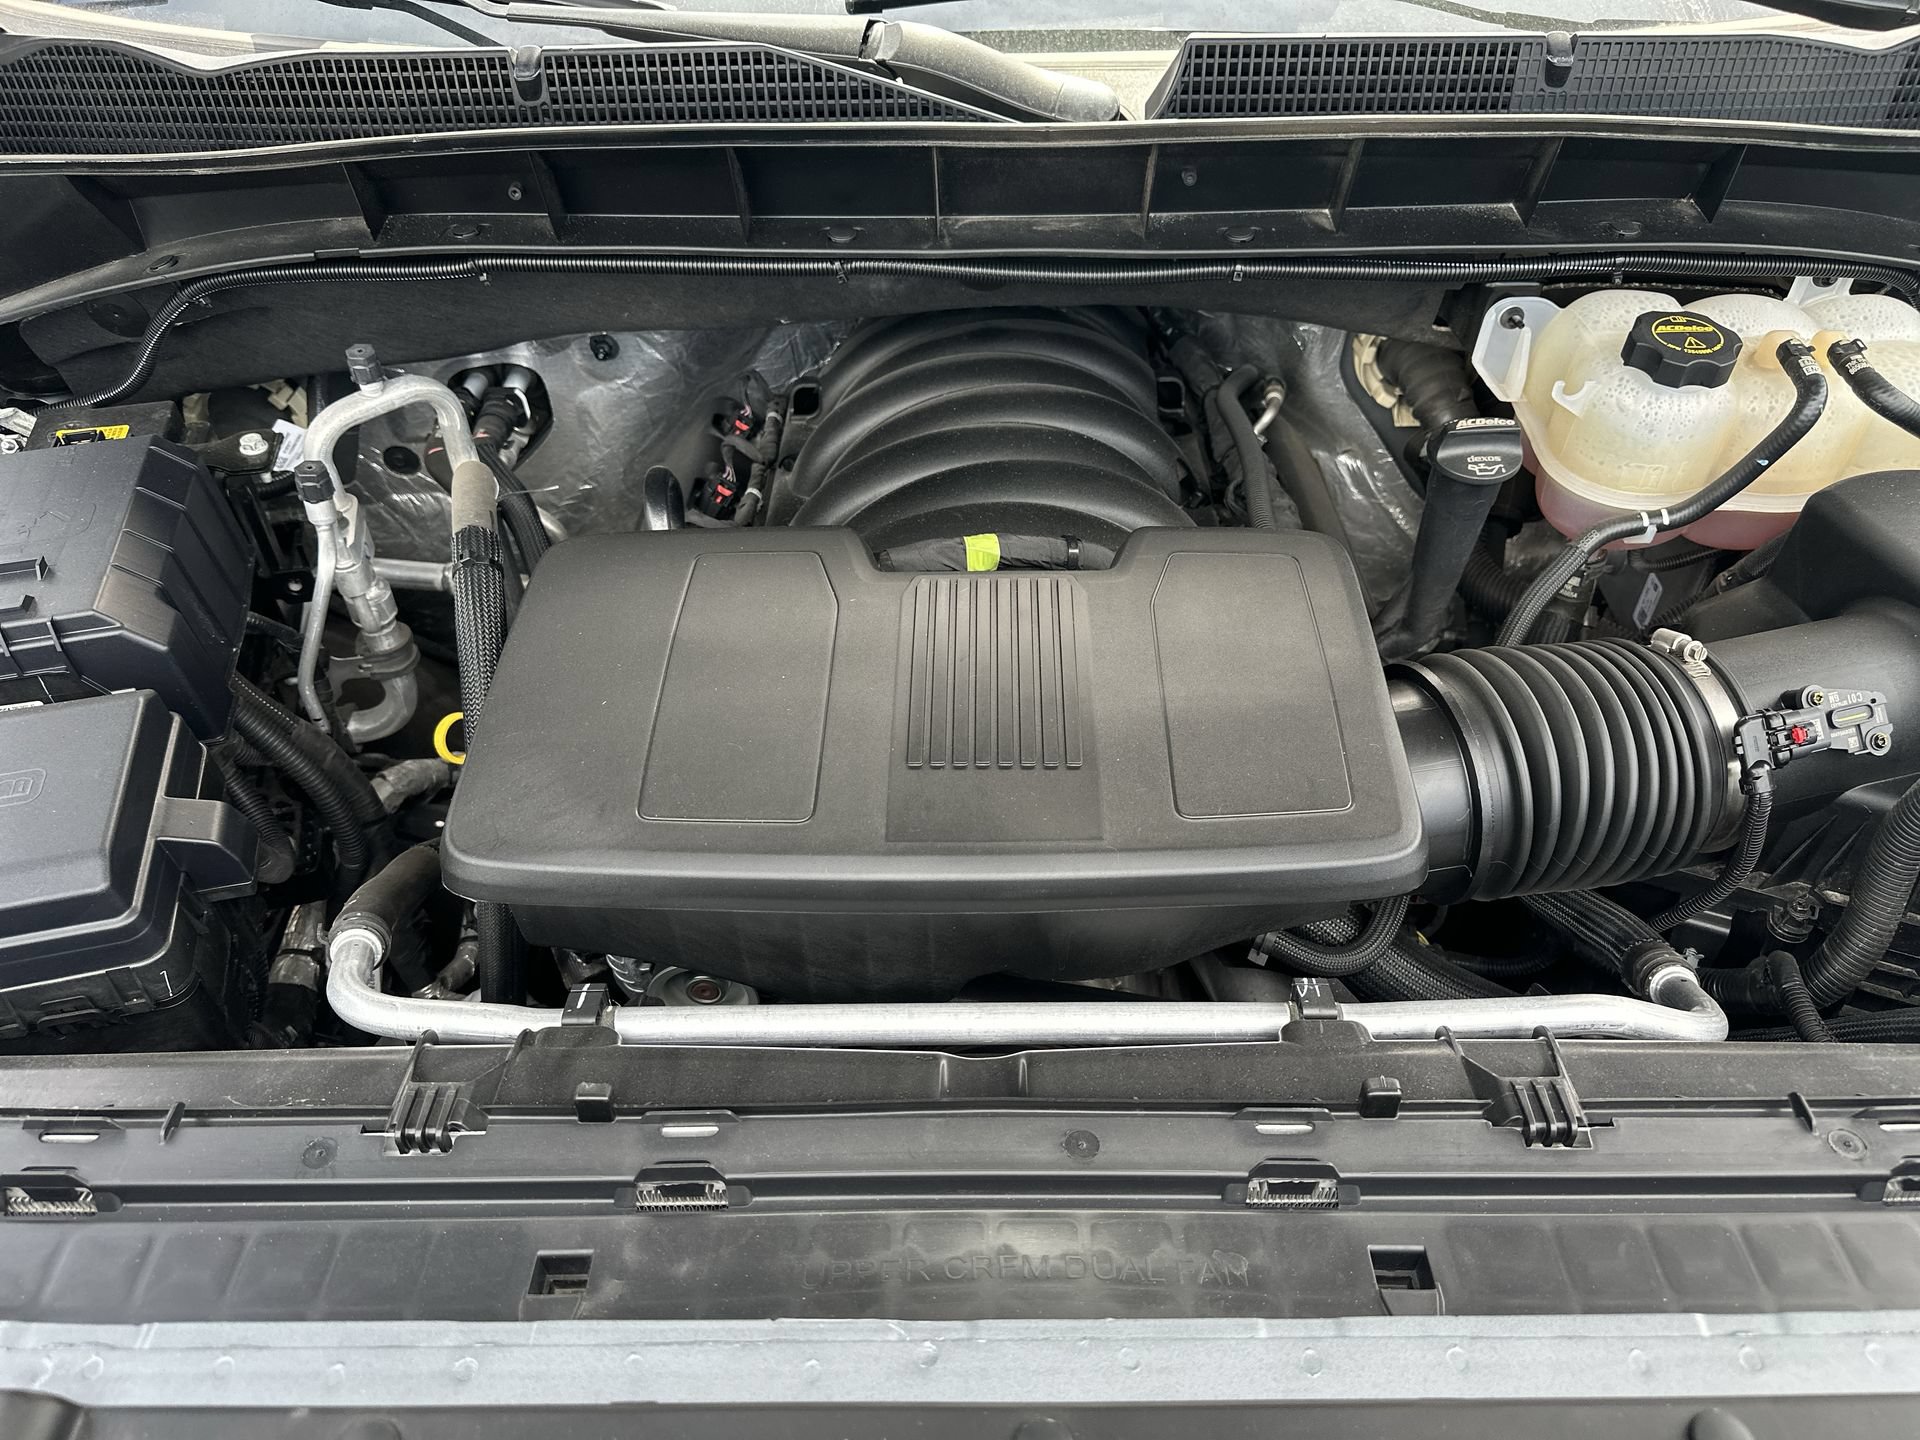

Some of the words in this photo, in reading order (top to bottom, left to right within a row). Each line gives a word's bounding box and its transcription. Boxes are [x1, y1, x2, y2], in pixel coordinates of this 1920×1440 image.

[1655, 325, 1714, 333] ACDelco
[1456, 418, 1516, 430] ACDelco
[1466, 455, 1502, 463] dexos
[1065, 1255, 1166, 1283] DUAL
[1178, 1249, 1249, 1287] FAN
